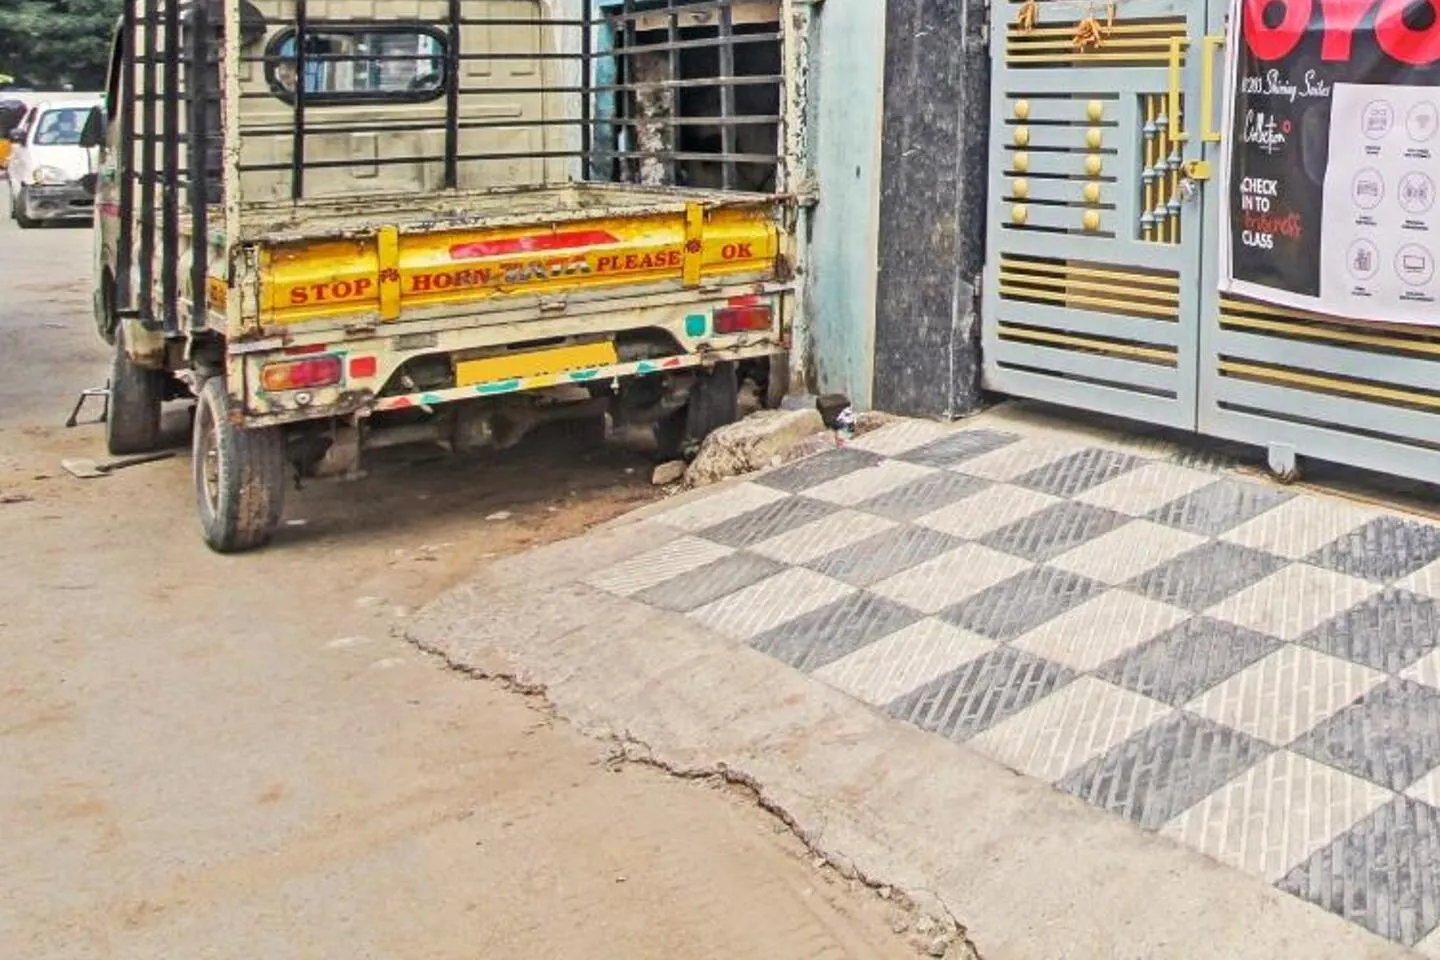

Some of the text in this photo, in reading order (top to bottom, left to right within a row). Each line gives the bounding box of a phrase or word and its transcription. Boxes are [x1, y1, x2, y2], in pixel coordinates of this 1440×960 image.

[1241, 177, 1278, 197] CHECK
[1242, 194, 1270, 213] IN TO
[1241, 230, 1274, 249] CLASS
[290, 277, 372, 305] STOP
[412, 267, 492, 292] HORN
[596, 250, 682, 272] PLEASE
[720, 242, 754, 260] OK
